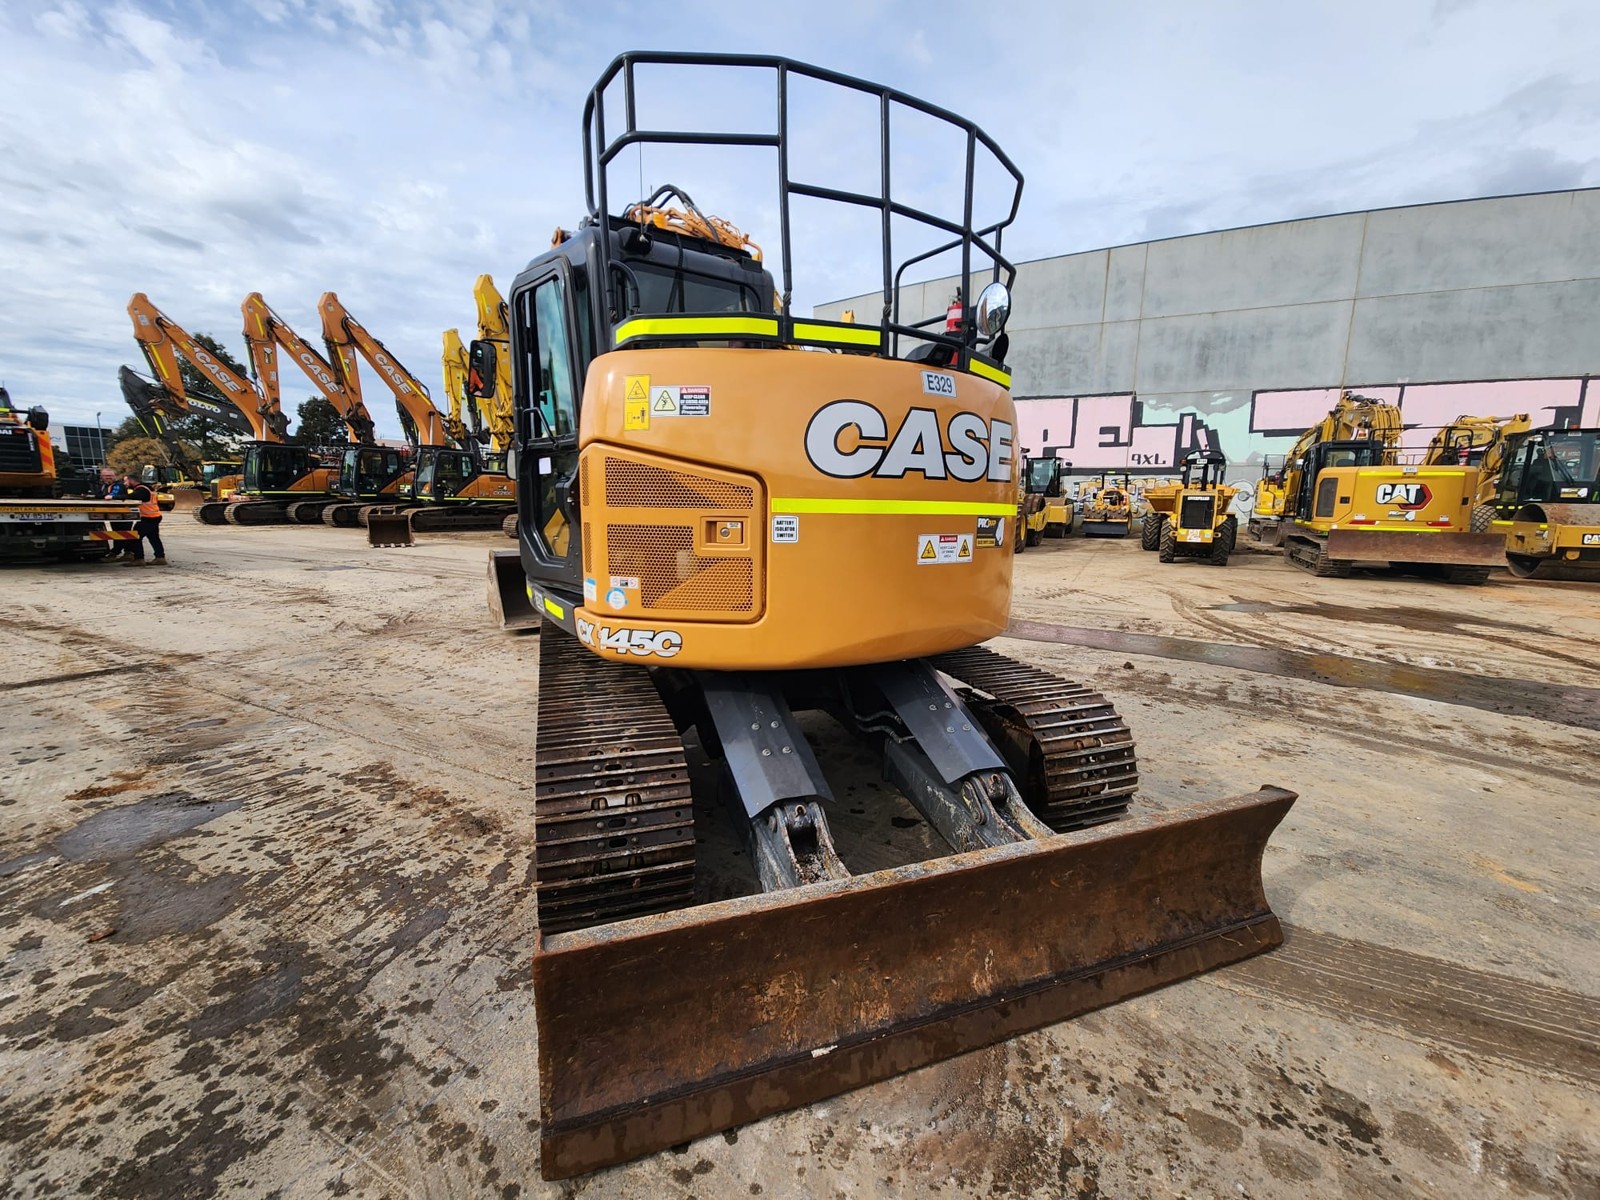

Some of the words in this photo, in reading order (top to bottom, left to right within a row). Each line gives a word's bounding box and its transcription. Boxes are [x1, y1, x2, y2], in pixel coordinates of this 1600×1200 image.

[195, 352, 241, 392] CASE
[300, 352, 339, 393] CASE
[374, 353, 412, 394] CASE
[926, 374, 953, 393] E329
[186, 399, 222, 414] OLVO
[804, 398, 1012, 483] CASE
[1376, 483, 1421, 505] CAT
[1583, 534, 1600, 545] CA
[577, 617, 596, 647] CX
[599, 627, 682, 658] 145C
